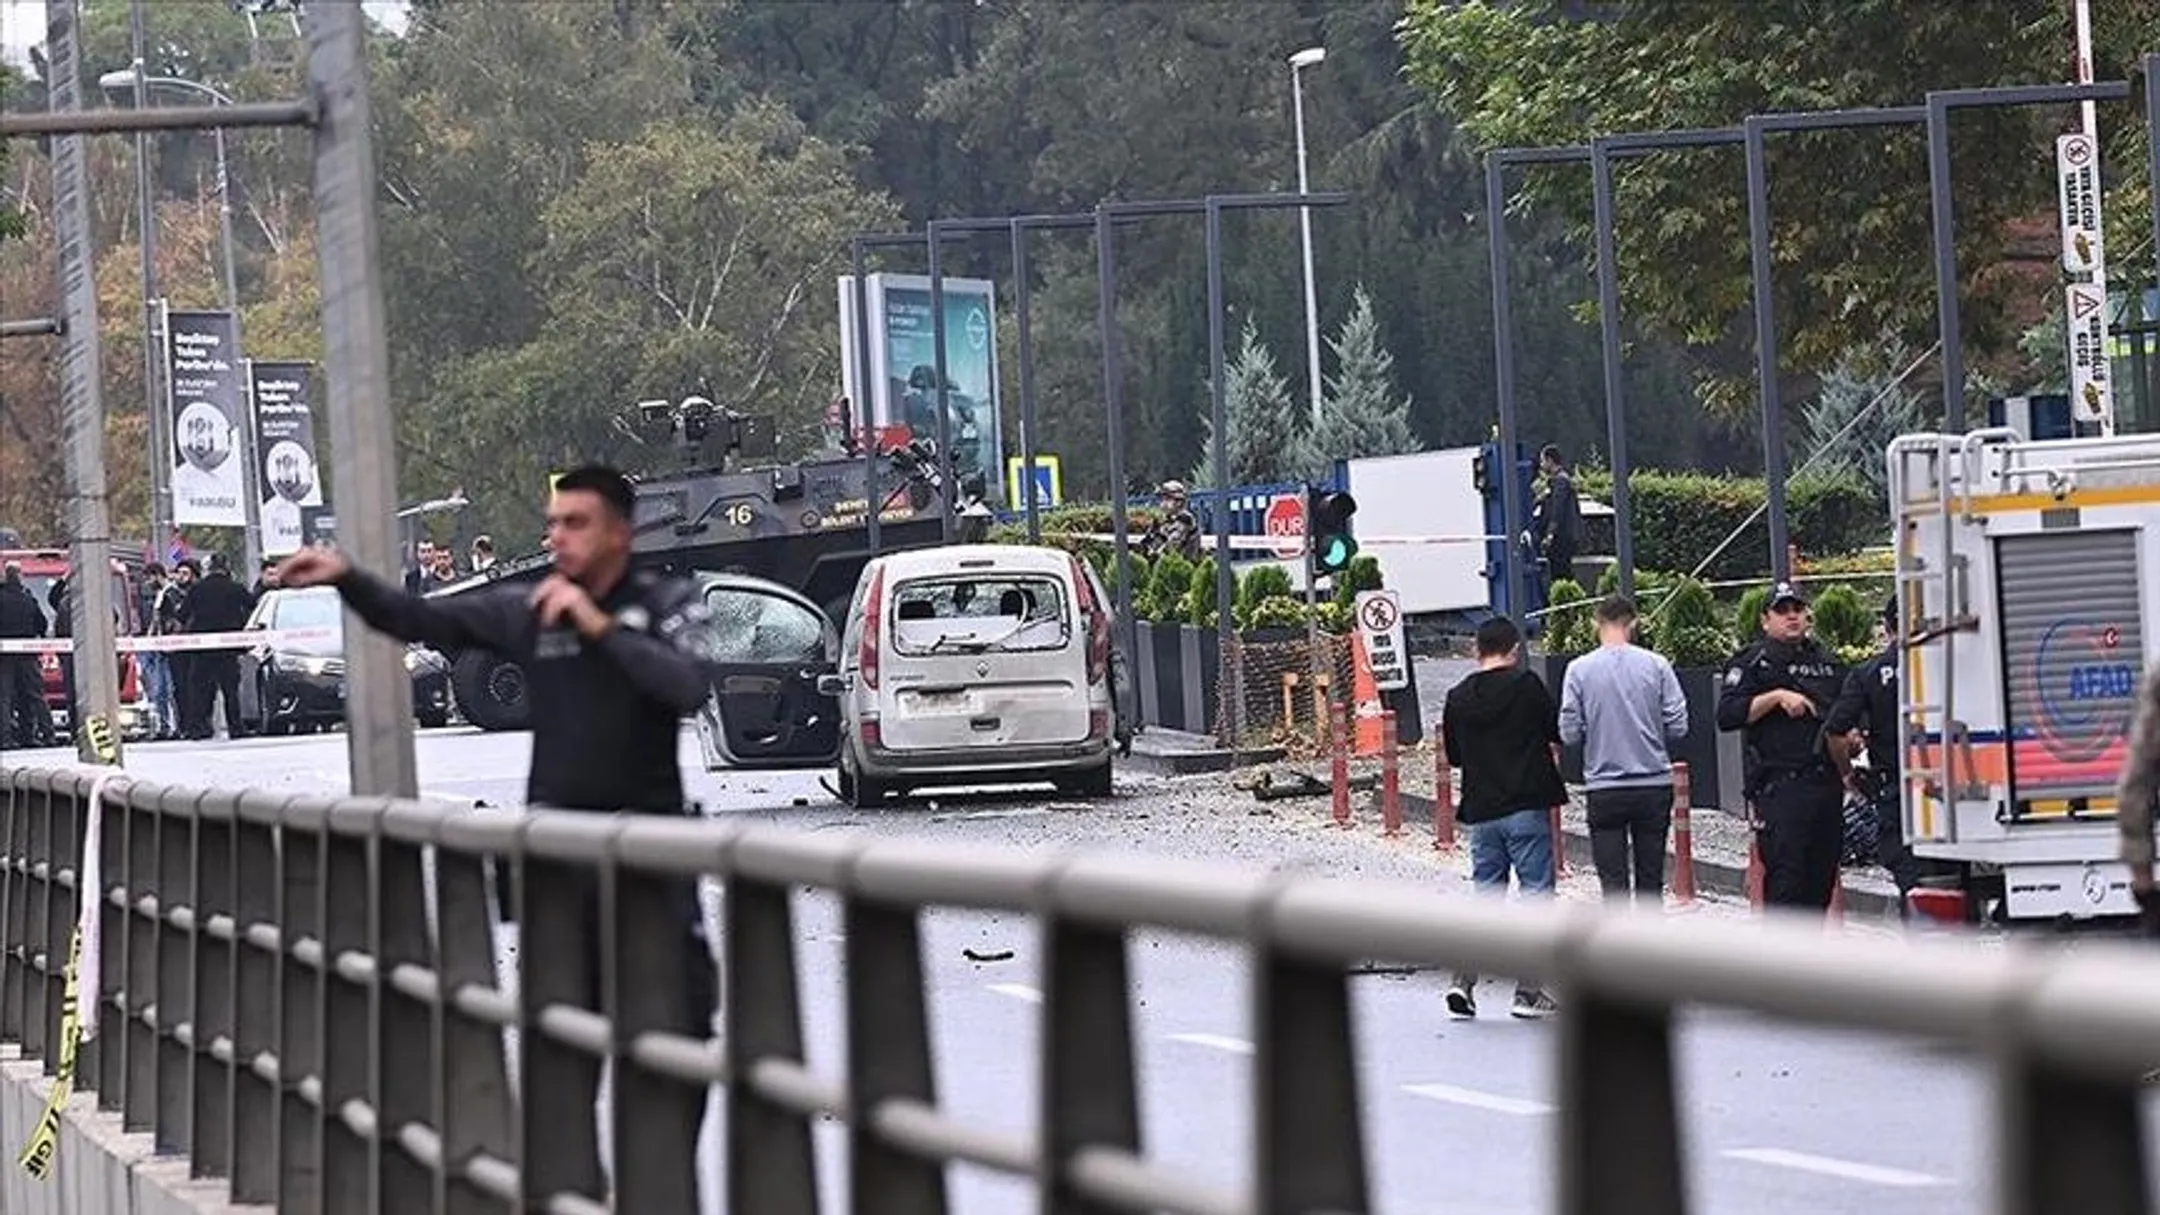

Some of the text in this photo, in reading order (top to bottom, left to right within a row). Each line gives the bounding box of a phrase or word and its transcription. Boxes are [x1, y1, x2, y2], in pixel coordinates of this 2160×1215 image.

[725, 504, 752, 527] 16
[1271, 516, 1304, 537] DUR
[2070, 665, 2132, 700] AFAD
